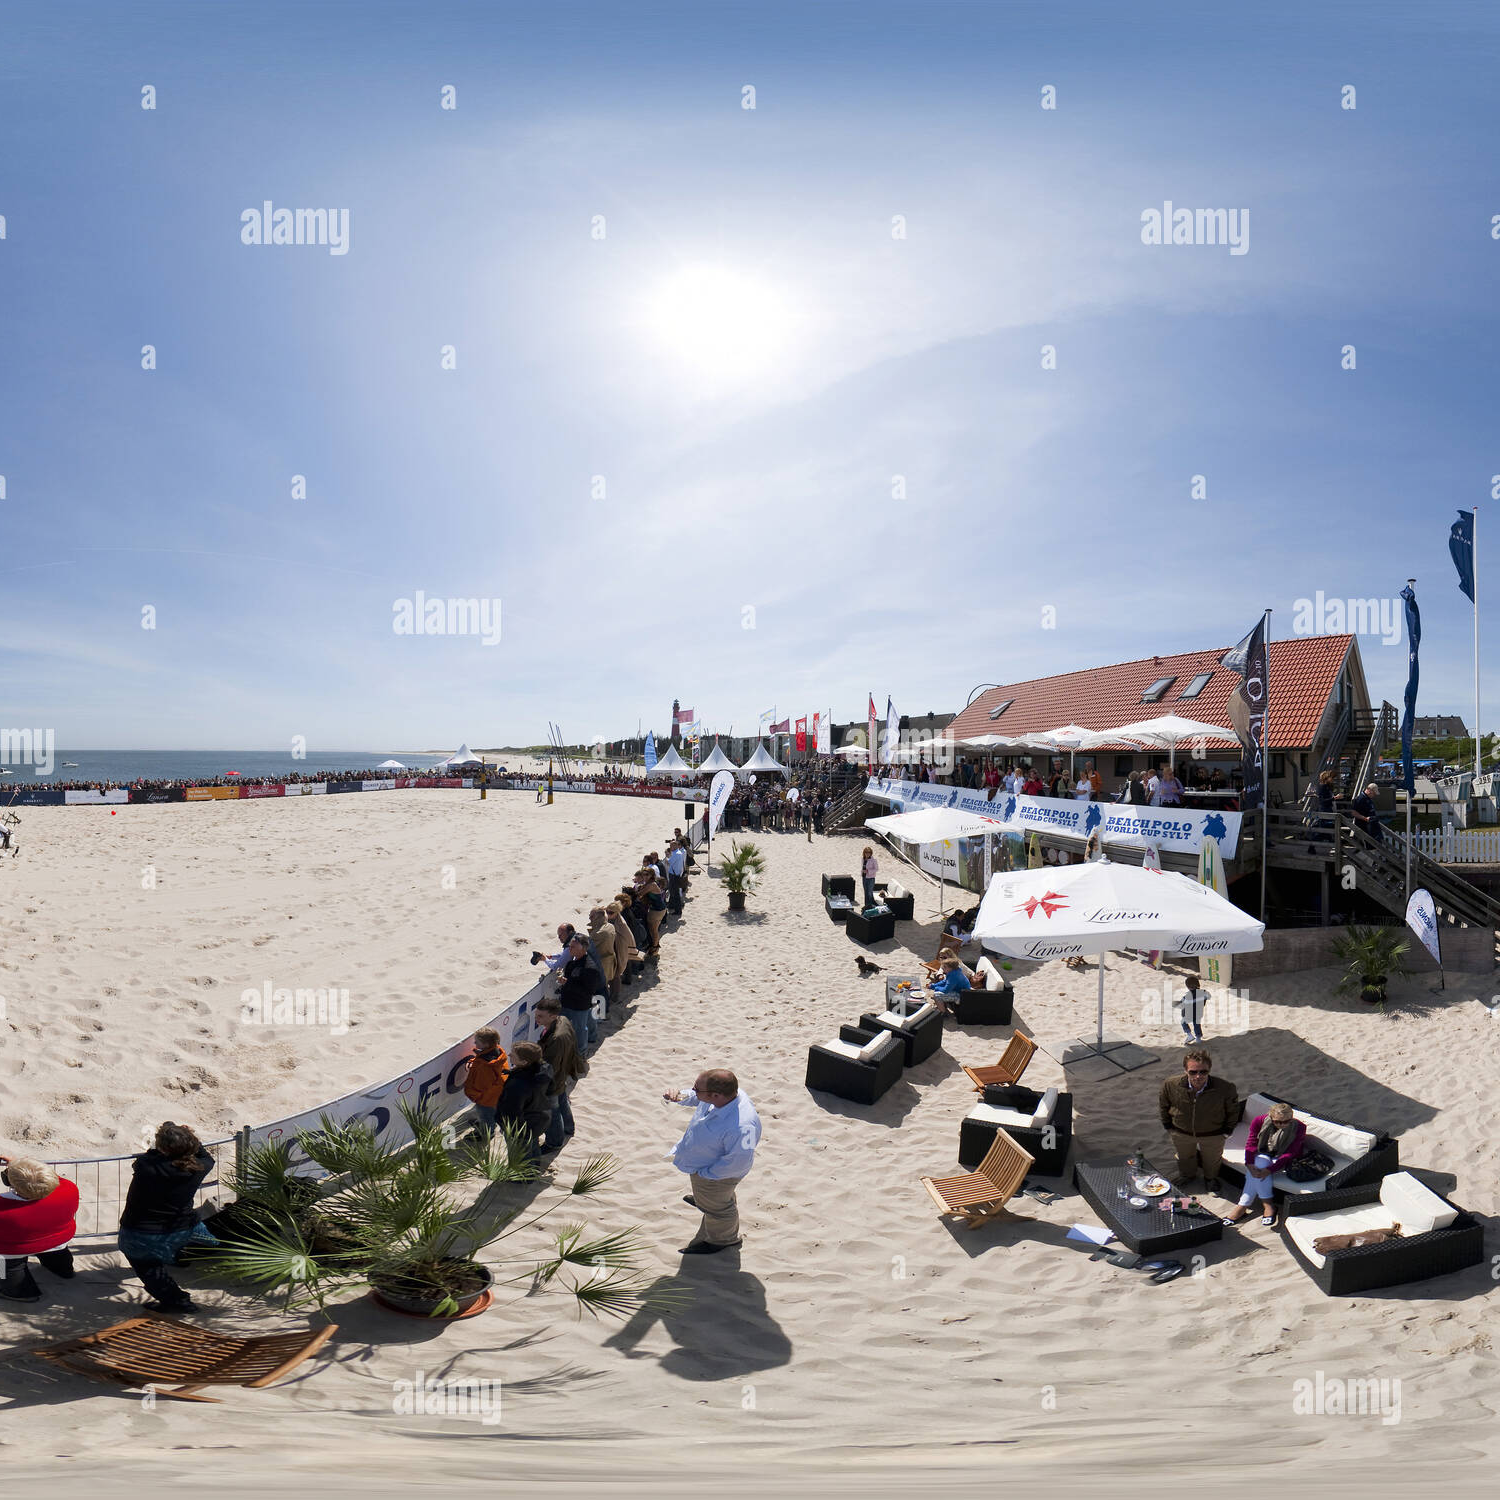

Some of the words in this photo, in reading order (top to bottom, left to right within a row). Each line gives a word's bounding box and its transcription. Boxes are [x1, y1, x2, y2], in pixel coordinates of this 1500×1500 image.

[568, 783, 591, 791] POLO
[712, 783, 725, 806] MAGNUS
[960, 803, 976, 811] WORLD
[976, 805, 988, 813] CUP
[987, 807, 1002, 816] SYLT
[961, 797, 983, 807] BEACH
[983, 800, 1002, 810] POLO
[1019, 814, 1043, 824] WORLD
[1043, 816, 1058, 826] CUP
[1058, 817, 1078, 829] SYLT
[1021, 806, 1051, 818] BEACH
[1051, 809, 1079, 821] POLO
[1106, 816, 1149, 829] BEACH
[1150, 819, 1193, 833] POLO
[1105, 825, 1139, 836] WORLD
[1139, 828, 1161, 838] CUP
[1161, 830, 1192, 842] SYLT
[923, 852, 930, 860] LA
[930, 854, 957, 868] MARINA
[1083, 906, 1163, 924] Lanson
[1024, 939, 1084, 961] Lanson
[1173, 933, 1229, 955] Lanson
